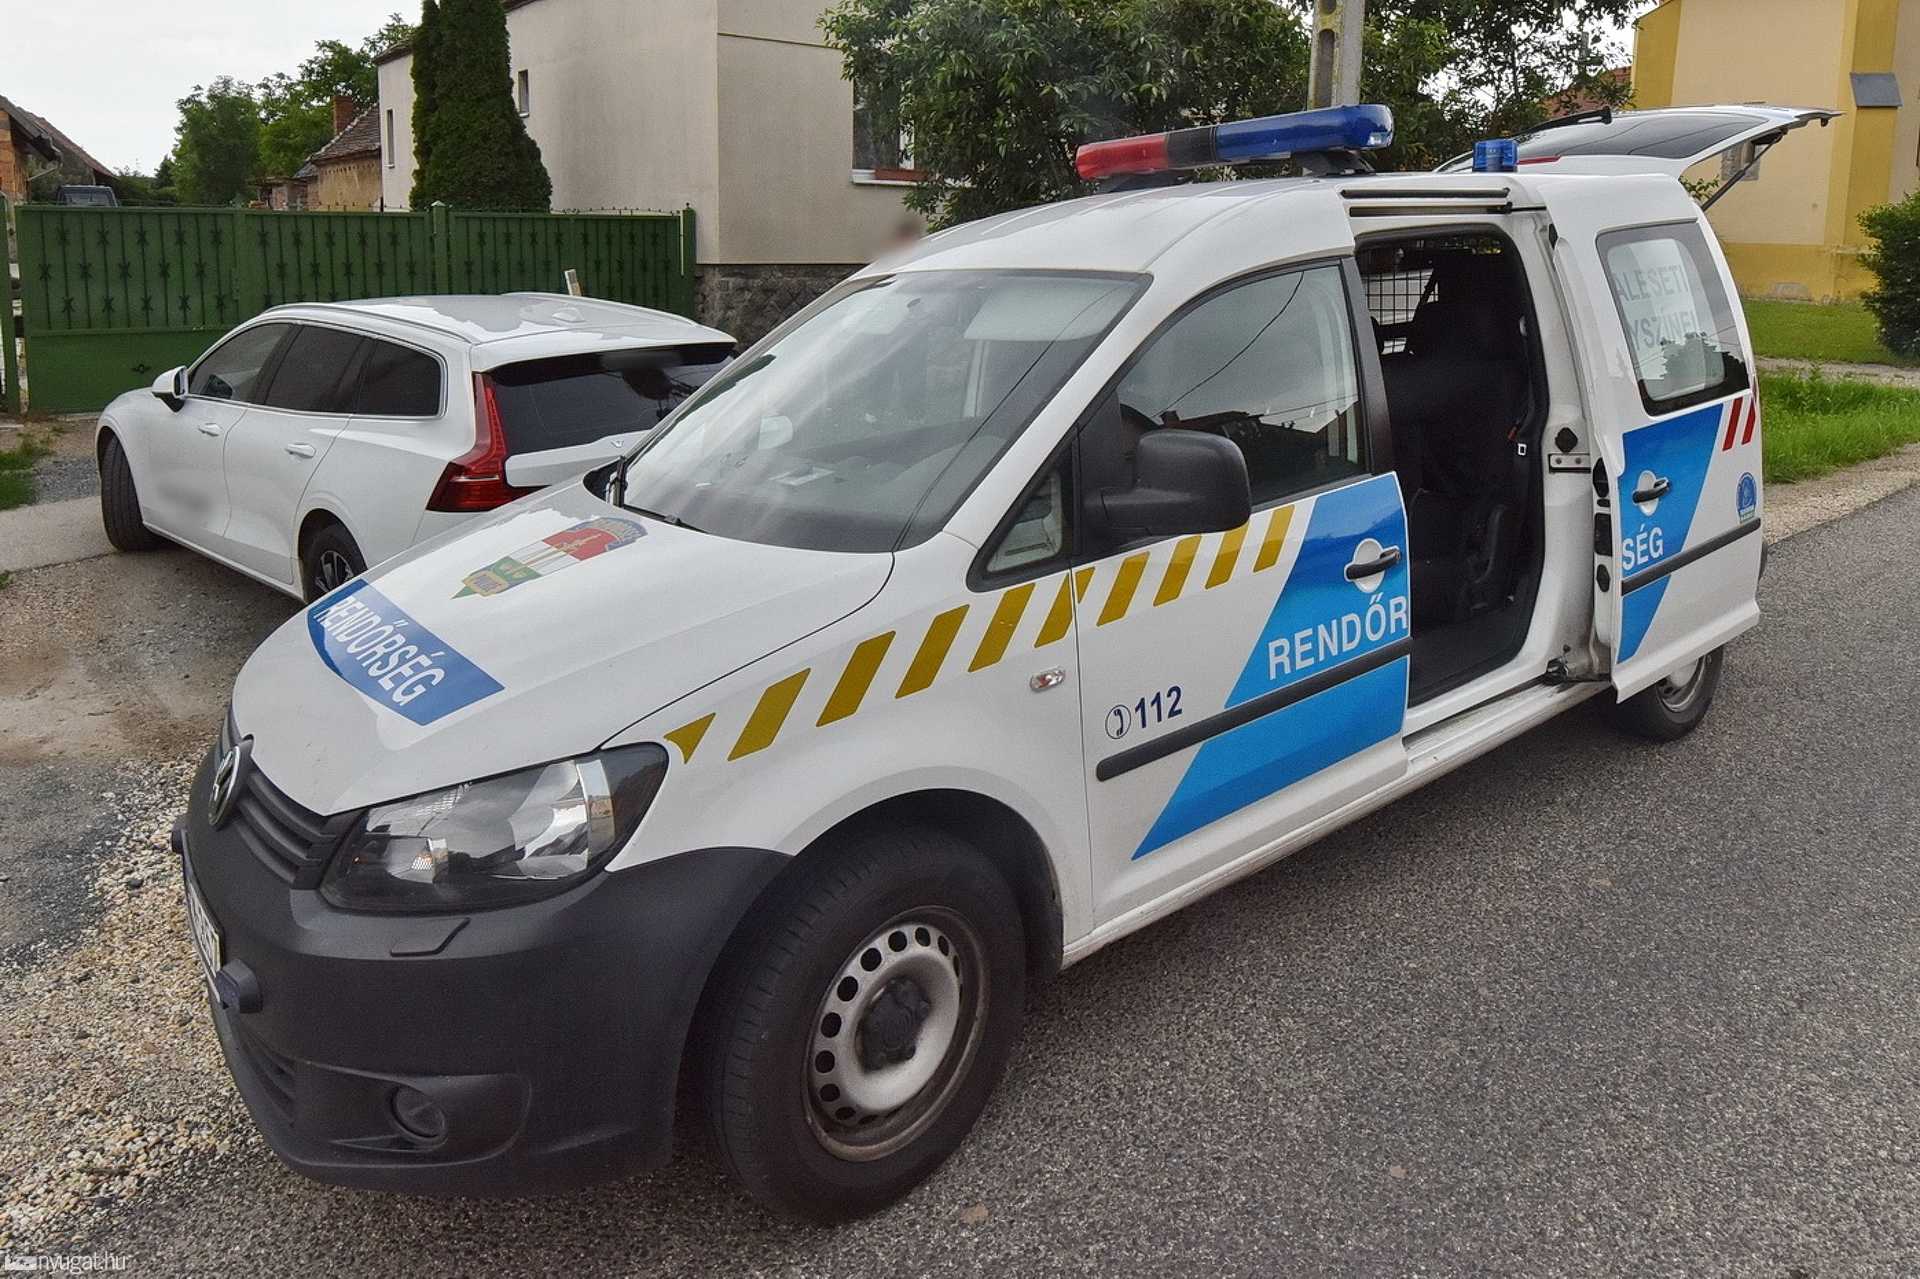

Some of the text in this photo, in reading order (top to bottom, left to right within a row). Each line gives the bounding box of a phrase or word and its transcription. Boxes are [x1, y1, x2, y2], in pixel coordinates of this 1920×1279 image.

[1622, 524, 1664, 571] SÉG
[313, 597, 446, 706] RENDŐRSÉG
[1268, 592, 1408, 681] RENDŐR
[1134, 685, 1183, 729] 112
